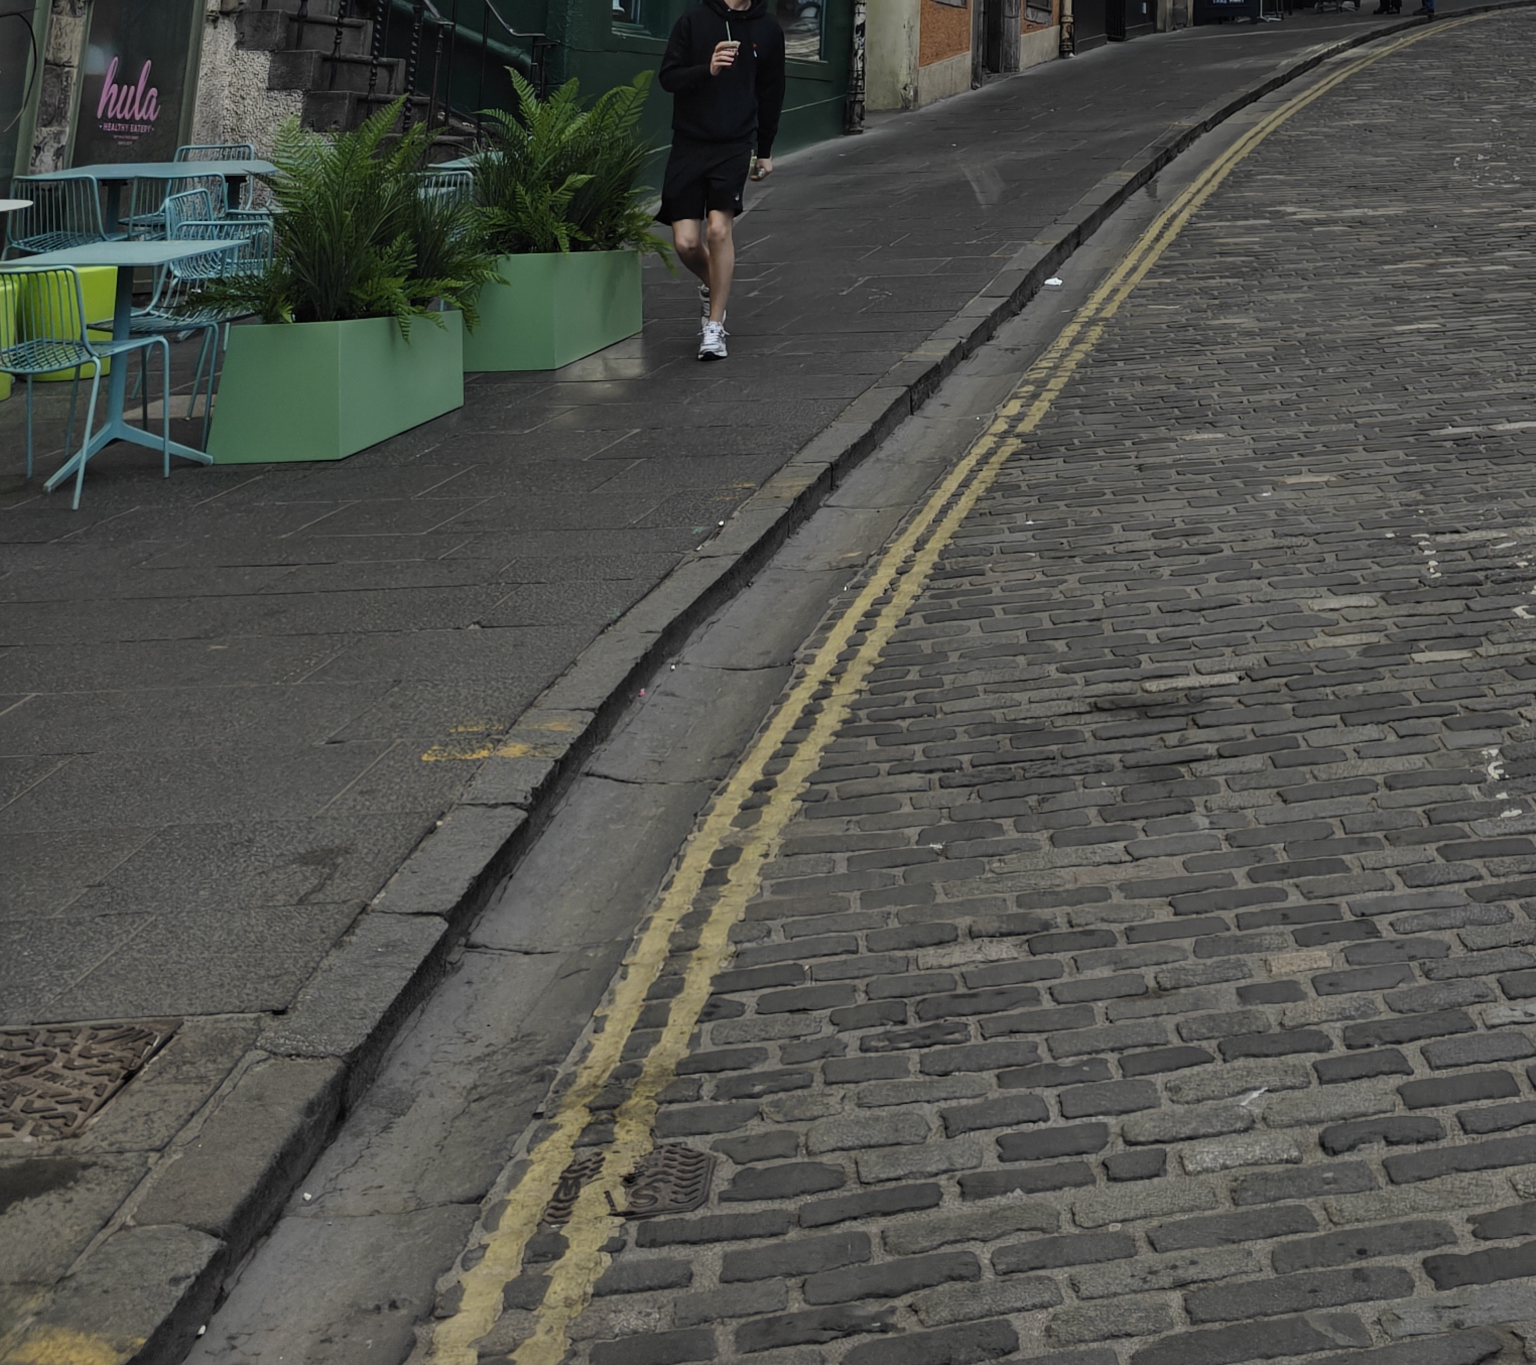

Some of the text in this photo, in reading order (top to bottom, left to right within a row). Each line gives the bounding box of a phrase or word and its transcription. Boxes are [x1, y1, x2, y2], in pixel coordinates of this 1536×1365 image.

[97, 56, 161, 122] hula
[102, 122, 152, 133] HEALTHY EATERY
